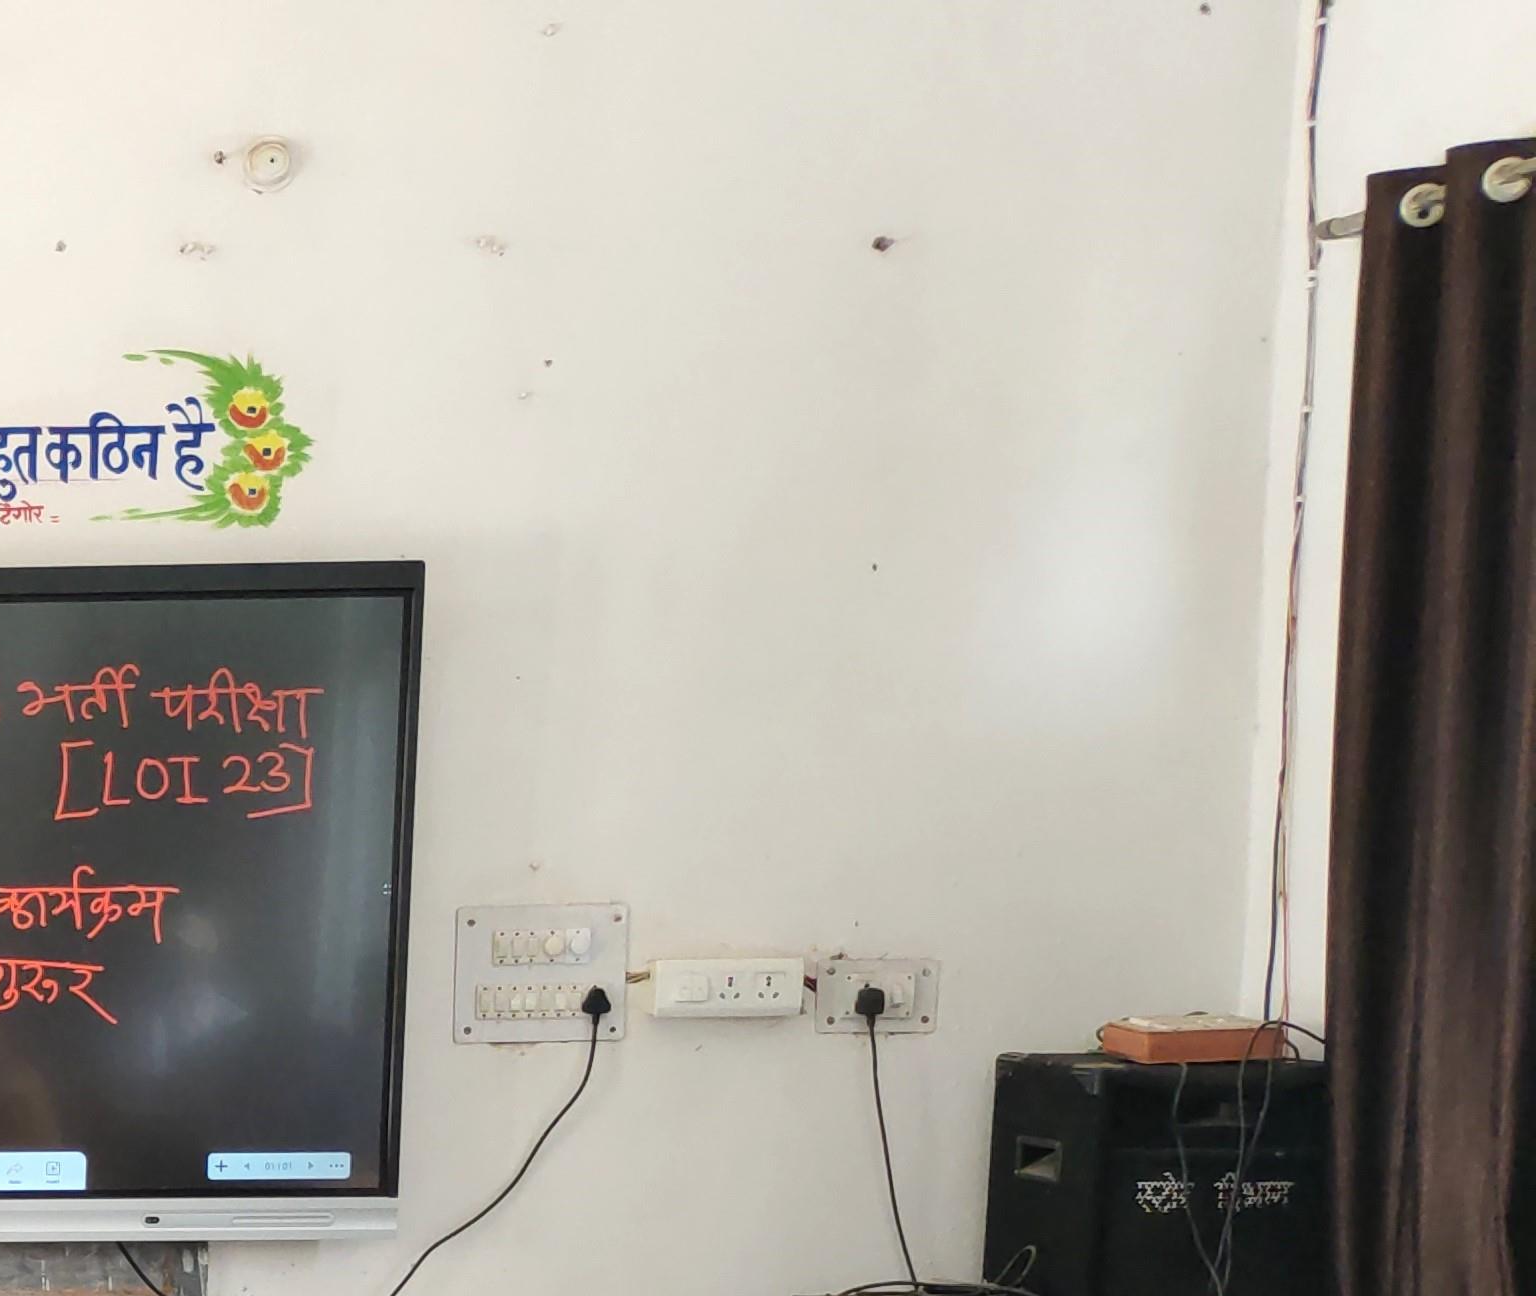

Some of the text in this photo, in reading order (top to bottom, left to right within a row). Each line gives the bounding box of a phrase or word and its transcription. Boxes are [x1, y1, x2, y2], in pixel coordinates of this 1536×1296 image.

[44, 410, 168, 487] कठिन
[168, 396, 216, 491] है
[16, 662, 141, 729] भर्ती
[150, 666, 325, 740] परीक्षा
